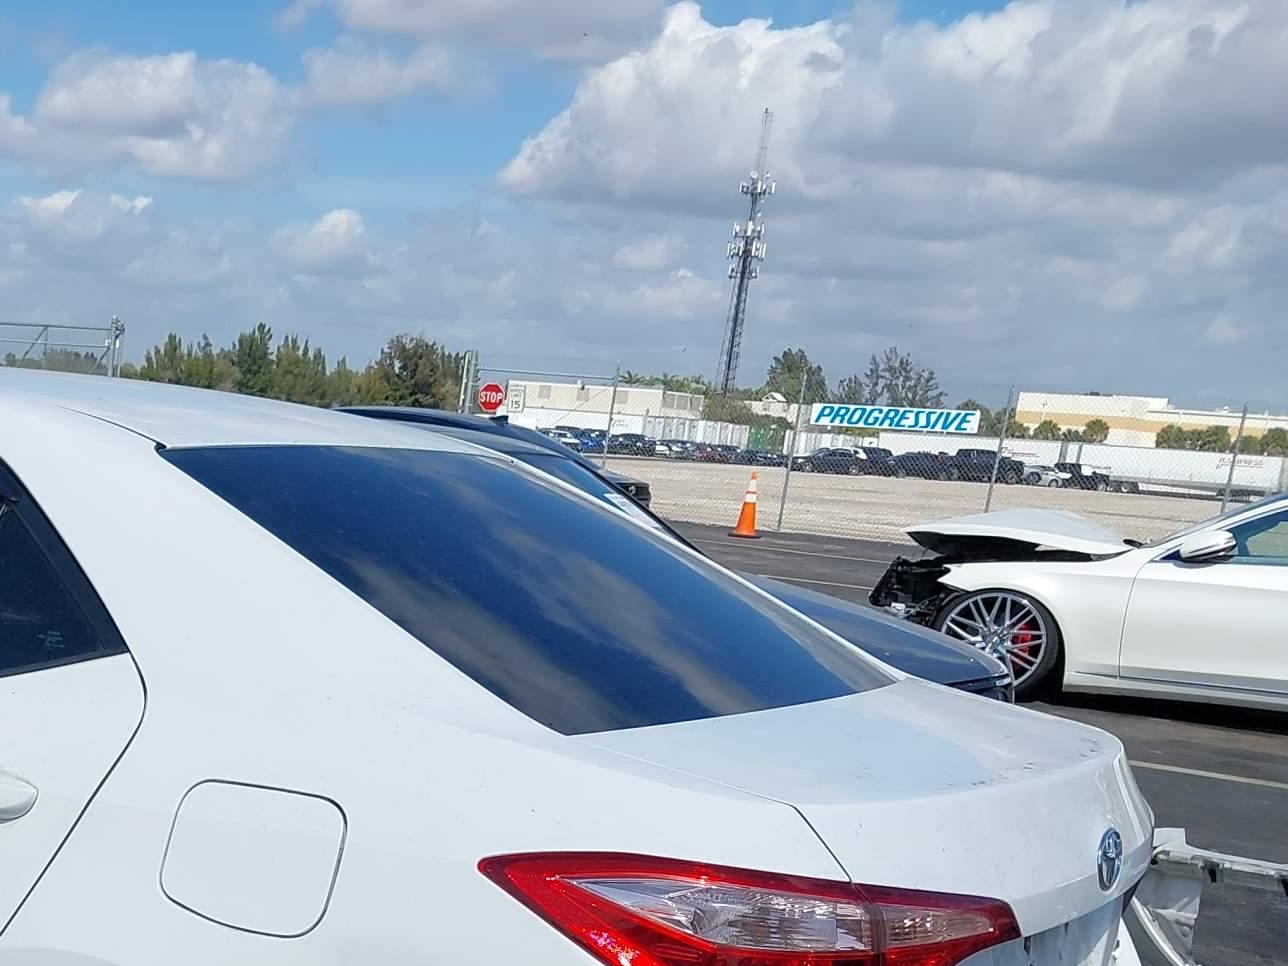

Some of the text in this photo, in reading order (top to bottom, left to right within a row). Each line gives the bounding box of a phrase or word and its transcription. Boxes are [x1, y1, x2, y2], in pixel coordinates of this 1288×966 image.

[480, 391, 503, 403] STOP
[510, 400, 521, 409] 15
[814, 405, 977, 432] PROGRESSIVE
